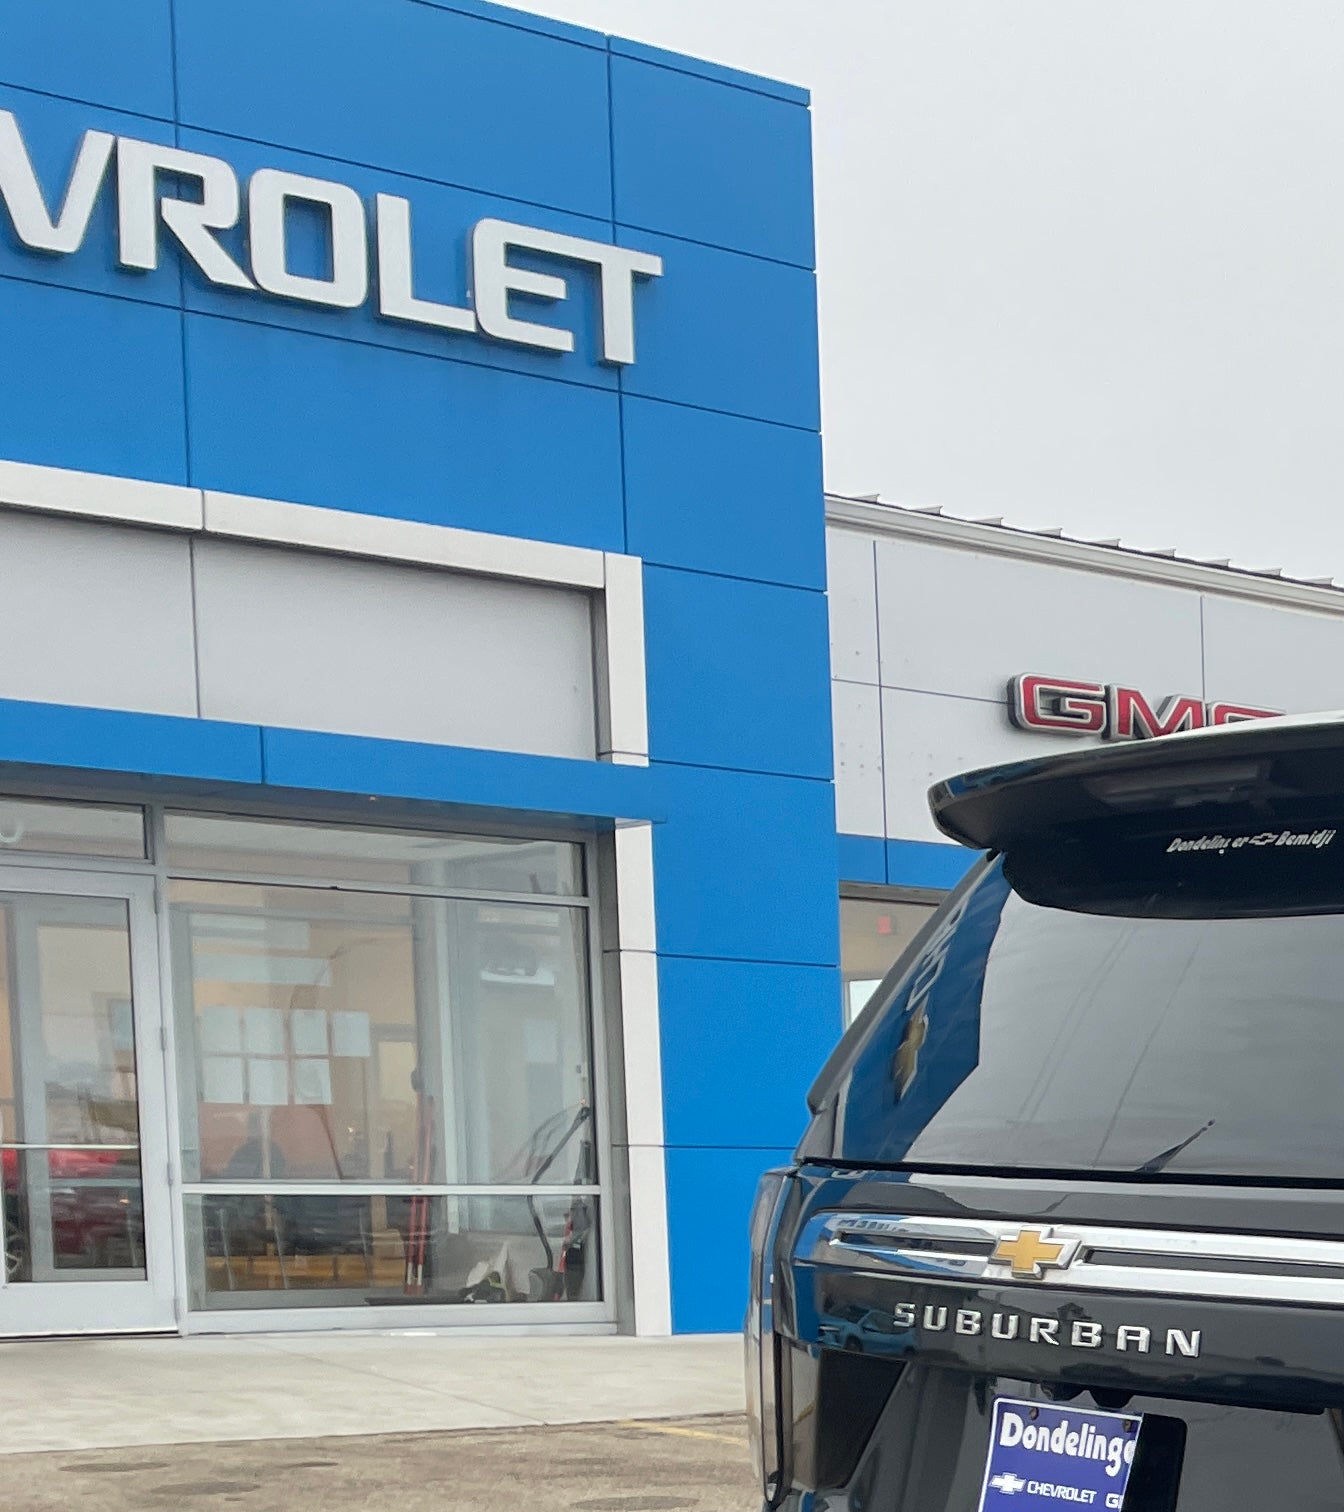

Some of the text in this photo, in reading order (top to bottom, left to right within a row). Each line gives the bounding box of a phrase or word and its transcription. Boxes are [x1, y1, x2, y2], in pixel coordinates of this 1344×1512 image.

[1274, 829, 1337, 848] Bemidji
[893, 1302, 1201, 1358] SUBURBAN
[1026, 1480, 1123, 1509] CHEVROLET G
